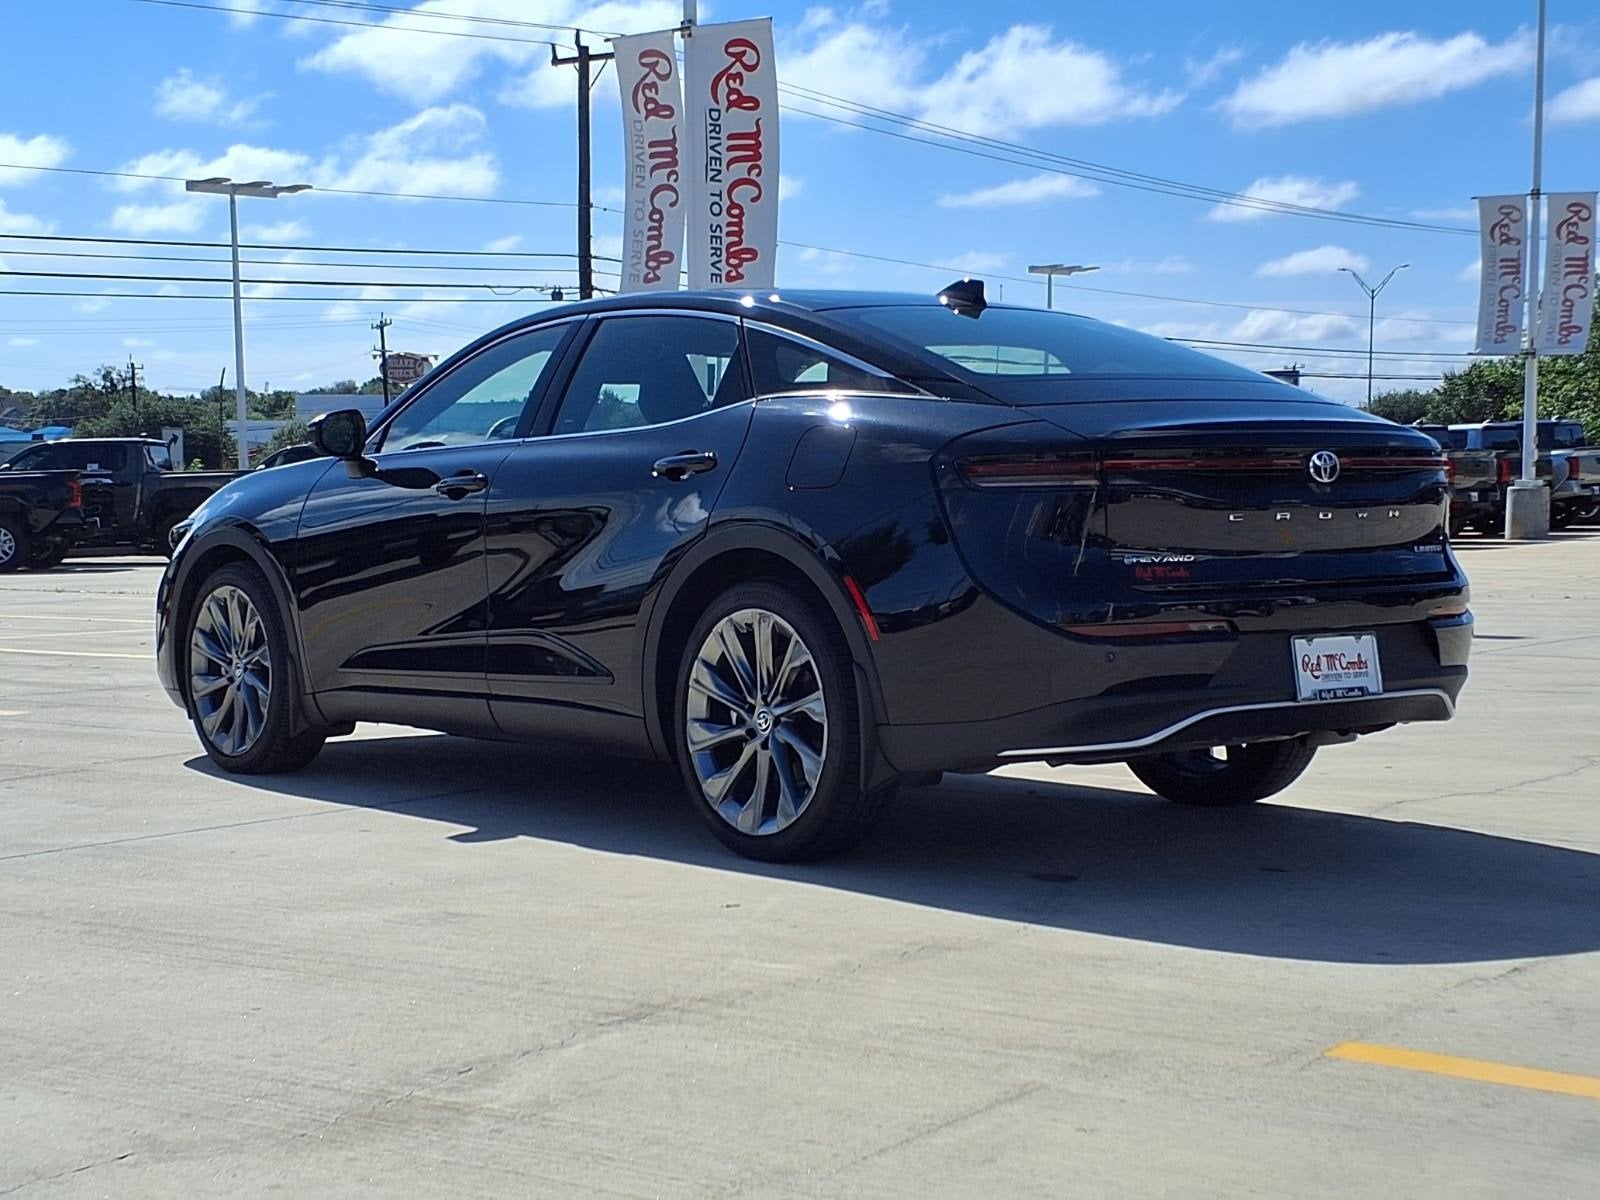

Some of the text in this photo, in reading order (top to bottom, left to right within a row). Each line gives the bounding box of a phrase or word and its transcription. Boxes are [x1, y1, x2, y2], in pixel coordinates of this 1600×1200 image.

[629, 119, 646, 284] DRIVEN TO SERVE
[632, 48, 680, 285] Red McCombs
[708, 108, 723, 285] DRIVEN TO SERVE
[710, 37, 763, 284] Red McCombs
[1489, 204, 1522, 345] Red McCombs
[1556, 202, 1592, 345] Red McCombs
[387, 369, 415, 378] CHECK
[1228, 509, 1400, 521] CROWN
[1302, 653, 1368, 679] Red McCombs
